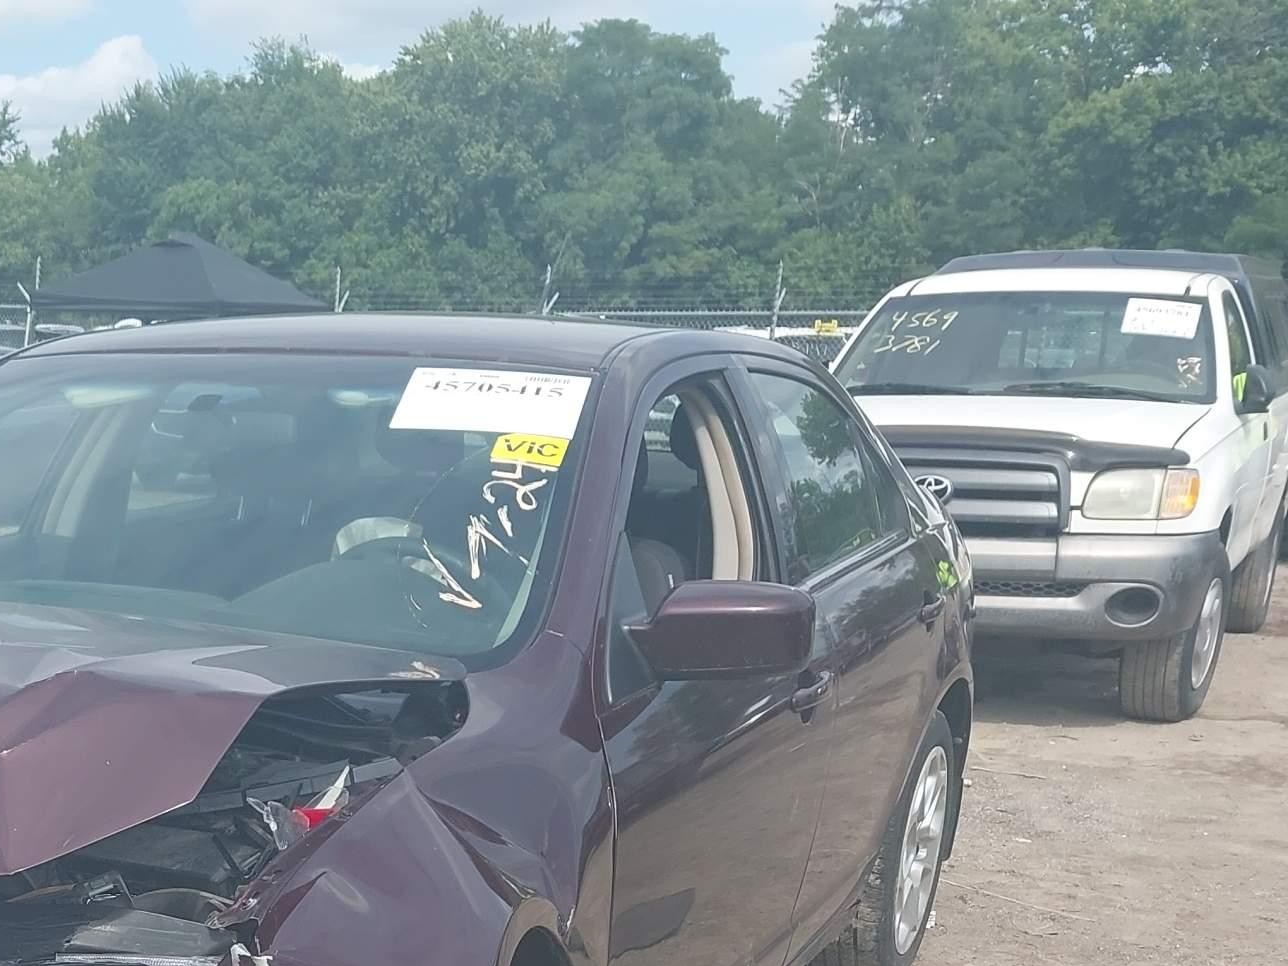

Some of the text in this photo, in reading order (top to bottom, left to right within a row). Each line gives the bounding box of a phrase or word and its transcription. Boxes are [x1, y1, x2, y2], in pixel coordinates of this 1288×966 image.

[892, 308, 959, 331] 4569
[873, 334, 940, 355] 3781
[425, 380, 565, 399] 45705415
